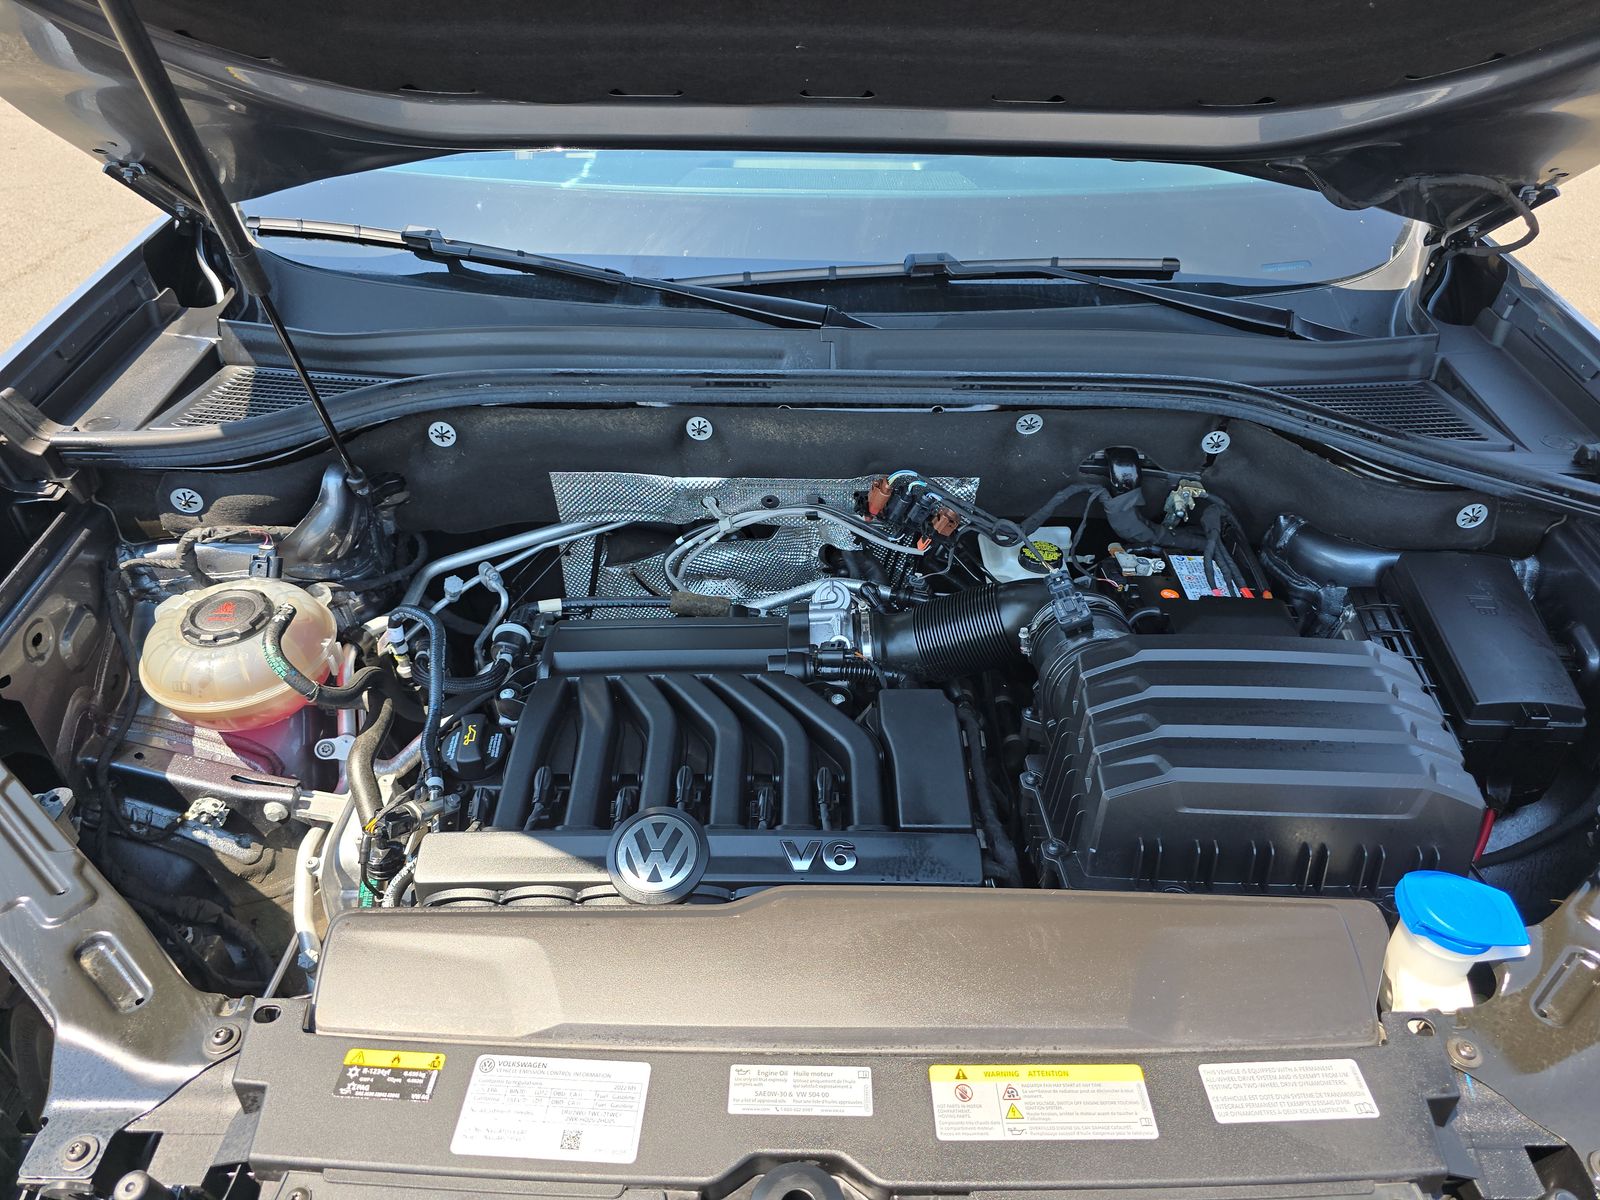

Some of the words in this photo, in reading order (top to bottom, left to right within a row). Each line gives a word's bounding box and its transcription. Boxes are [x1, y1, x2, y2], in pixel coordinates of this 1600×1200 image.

[617, 815, 700, 892] VW
[780, 840, 858, 873] V6
[498, 1060, 548, 1069] VOLKSWAGEN
[573, 1071, 612, 1079] INFORMATION
[1248, 1067, 1276, 1075] EQUIPPED
